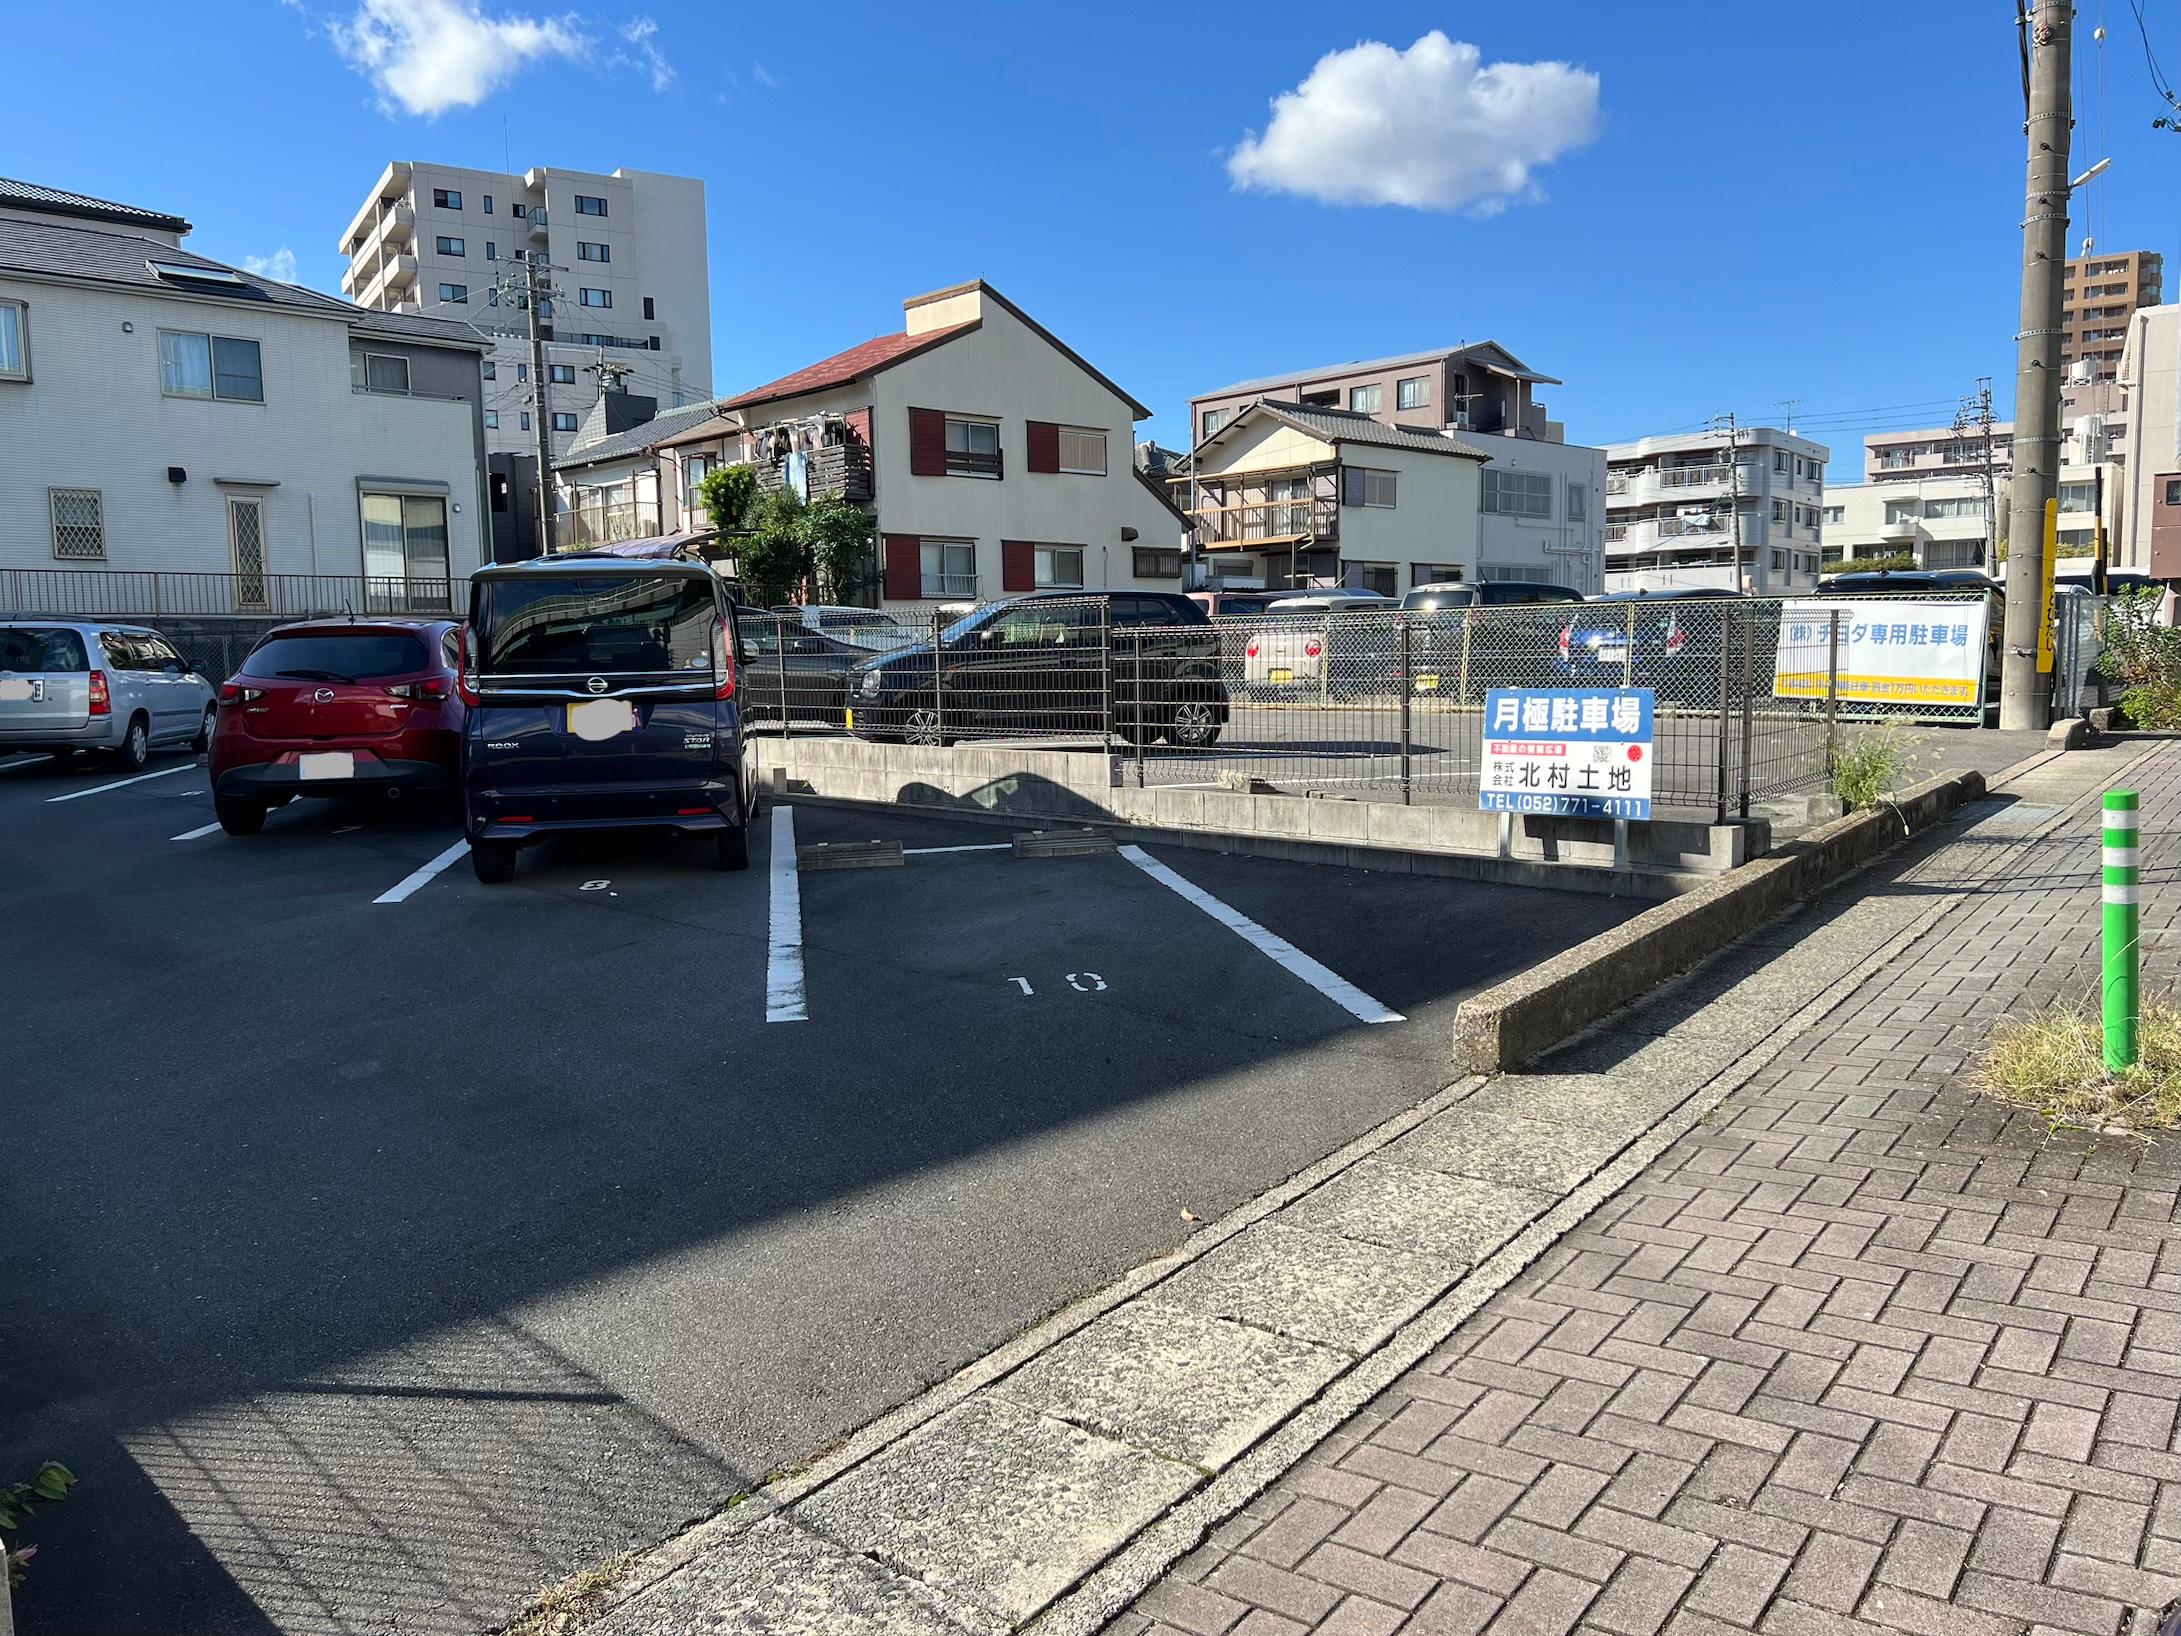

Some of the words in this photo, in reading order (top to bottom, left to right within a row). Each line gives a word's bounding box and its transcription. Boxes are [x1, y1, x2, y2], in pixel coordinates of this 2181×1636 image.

[1494, 696, 1640, 733] 月極駐車場
[1519, 762, 1631, 792] 北村土地
[1008, 972, 1107, 995] 10
